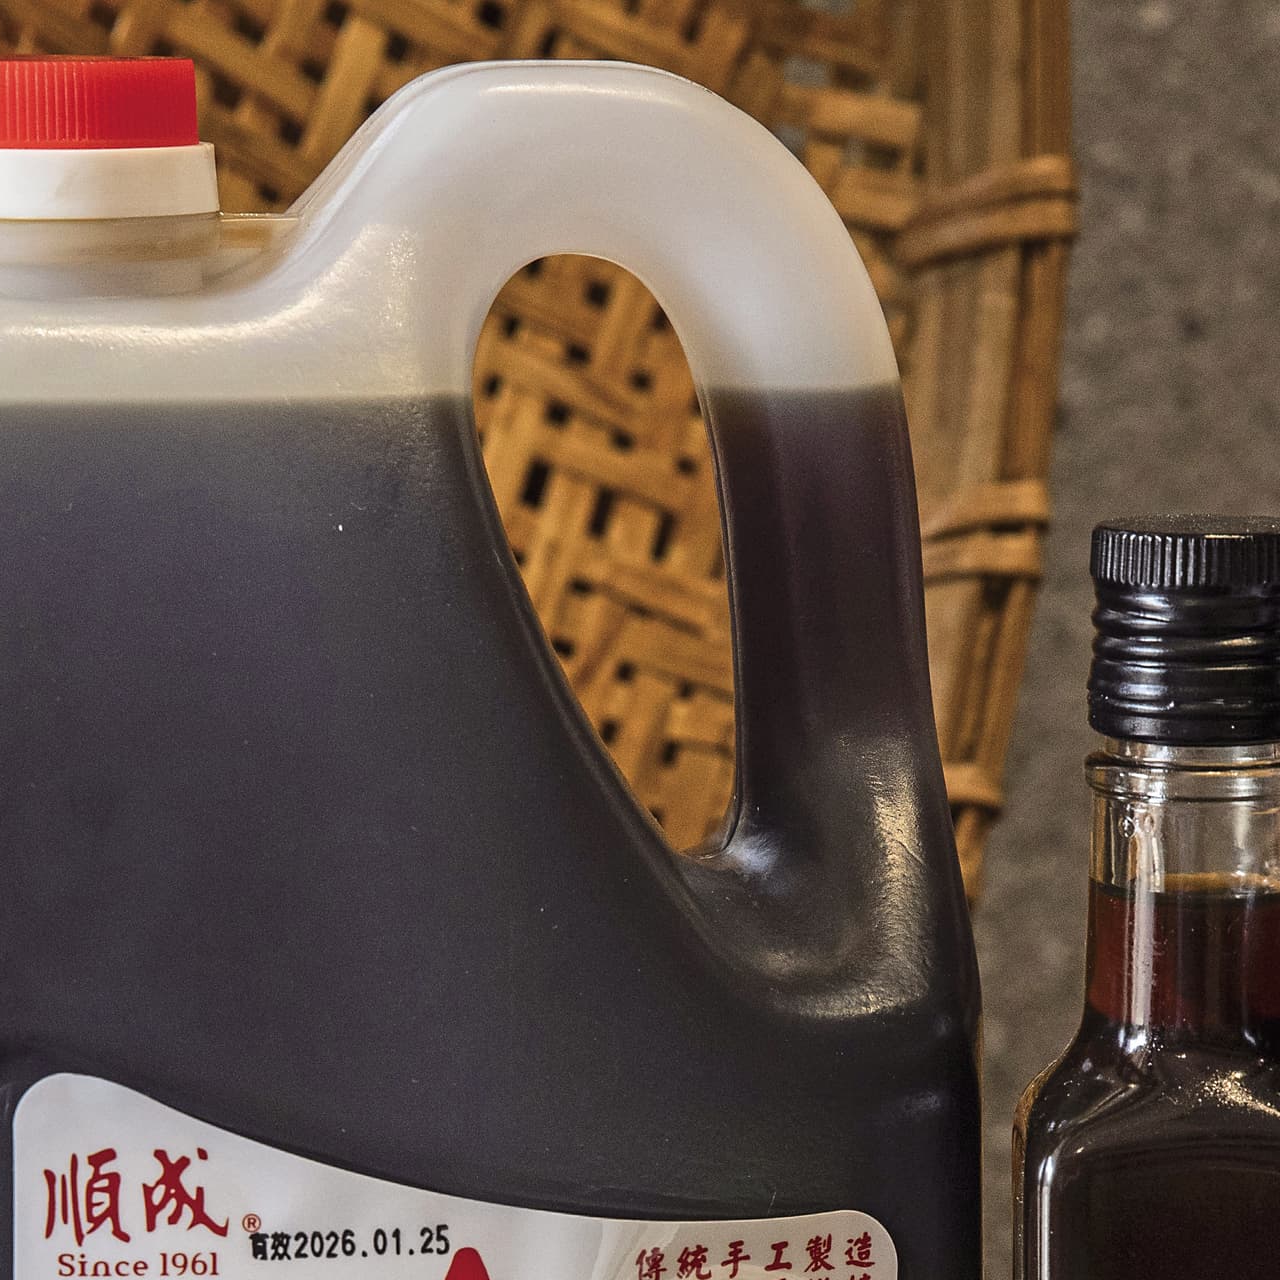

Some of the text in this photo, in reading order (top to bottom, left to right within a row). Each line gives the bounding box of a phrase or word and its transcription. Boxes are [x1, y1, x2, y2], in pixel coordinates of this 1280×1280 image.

[43, 1147, 230, 1247] 順成
[58, 1252, 219, 1277] Since 1961
